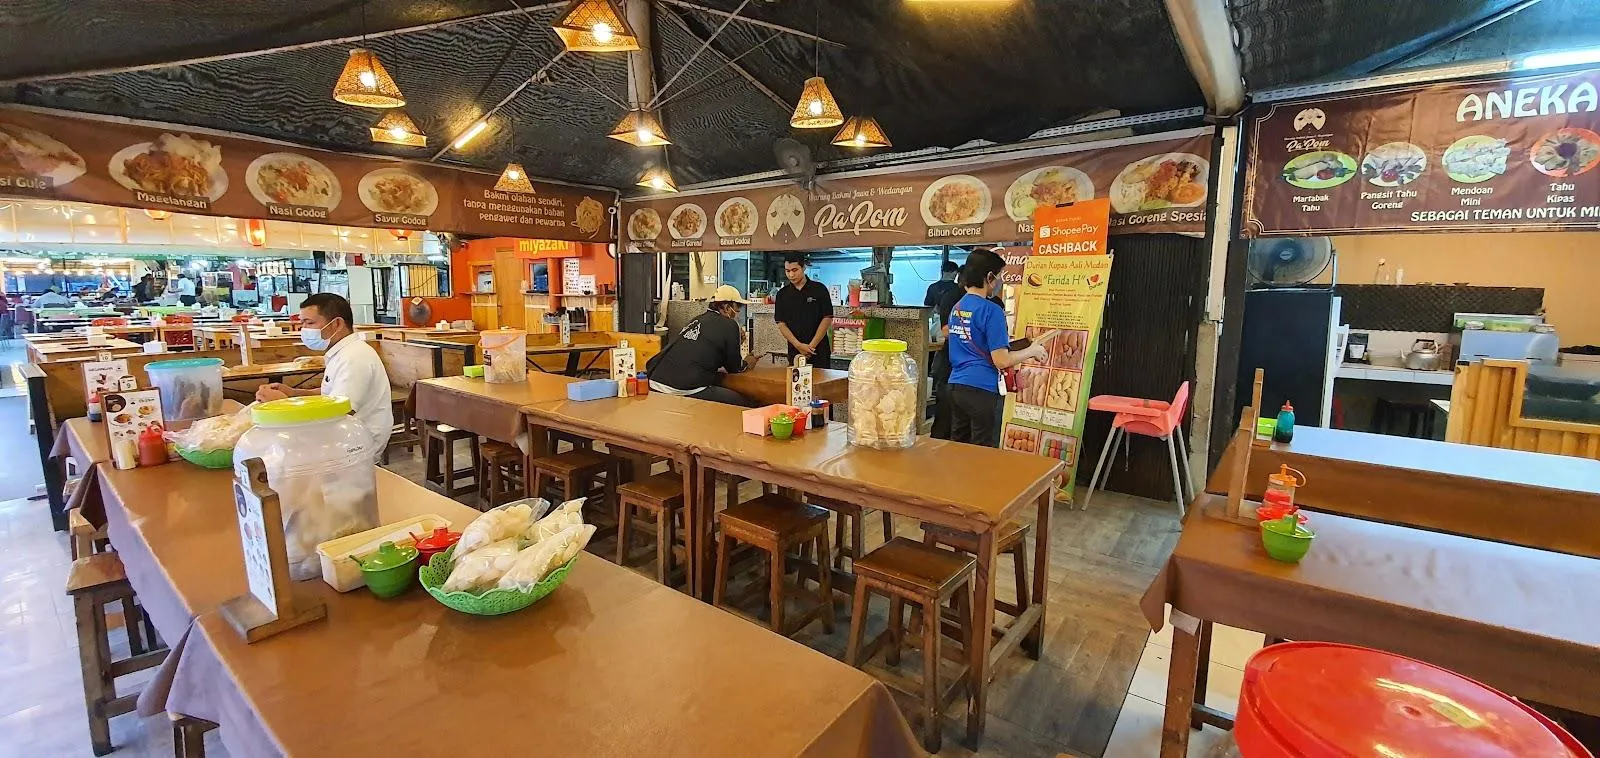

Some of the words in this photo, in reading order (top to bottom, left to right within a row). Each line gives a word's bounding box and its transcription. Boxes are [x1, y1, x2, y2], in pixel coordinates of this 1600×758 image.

[1456, 82, 1598, 122] ANEKA
[15, 177, 46, 190] Gule
[1550, 182, 1575, 191] Tahu
[484, 189, 509, 201] Bakmi
[511, 193, 536, 204] olahan
[870, 188, 876, 196] &
[877, 186, 913, 196] Wedangan
[1360, 190, 1394, 200] Pangsit
[1395, 189, 1418, 198] Tahu
[1451, 186, 1494, 196] Mendoan
[137, 192, 208, 209] Magelangan
[1292, 194, 1329, 203] Martabak
[1460, 197, 1481, 207] Mini
[1546, 194, 1575, 203] Kipas
[464, 199, 487, 210] tanpa
[488, 202, 543, 215] menggunakan
[544, 207, 565, 217] bahan
[1302, 204, 1320, 212] Tahu
[1371, 201, 1404, 210] Goreng
[269, 205, 293, 217] Nasi
[296, 207, 327, 219] Godog
[1410, 209, 1469, 222] SEBAGAI
[1473, 208, 1522, 220] TEMAN
[1526, 206, 1576, 219] UNTUK
[375, 214, 400, 224] Sayur
[401, 215, 427, 226] Godog
[479, 213, 518, 223] pengawet
[520, 216, 534, 225] dan
[535, 218, 566, 227] pewarna
[1128, 212, 1168, 225] Goreng
[928, 228, 950, 238] Bihun
[951, 226, 982, 236] Goreng
[1018, 223, 1035, 233] Nas
[1051, 223, 1099, 238] ShopeePay
[519, 239, 569, 255] miyazaki
[1038, 240, 1098, 255] CASHBACK
